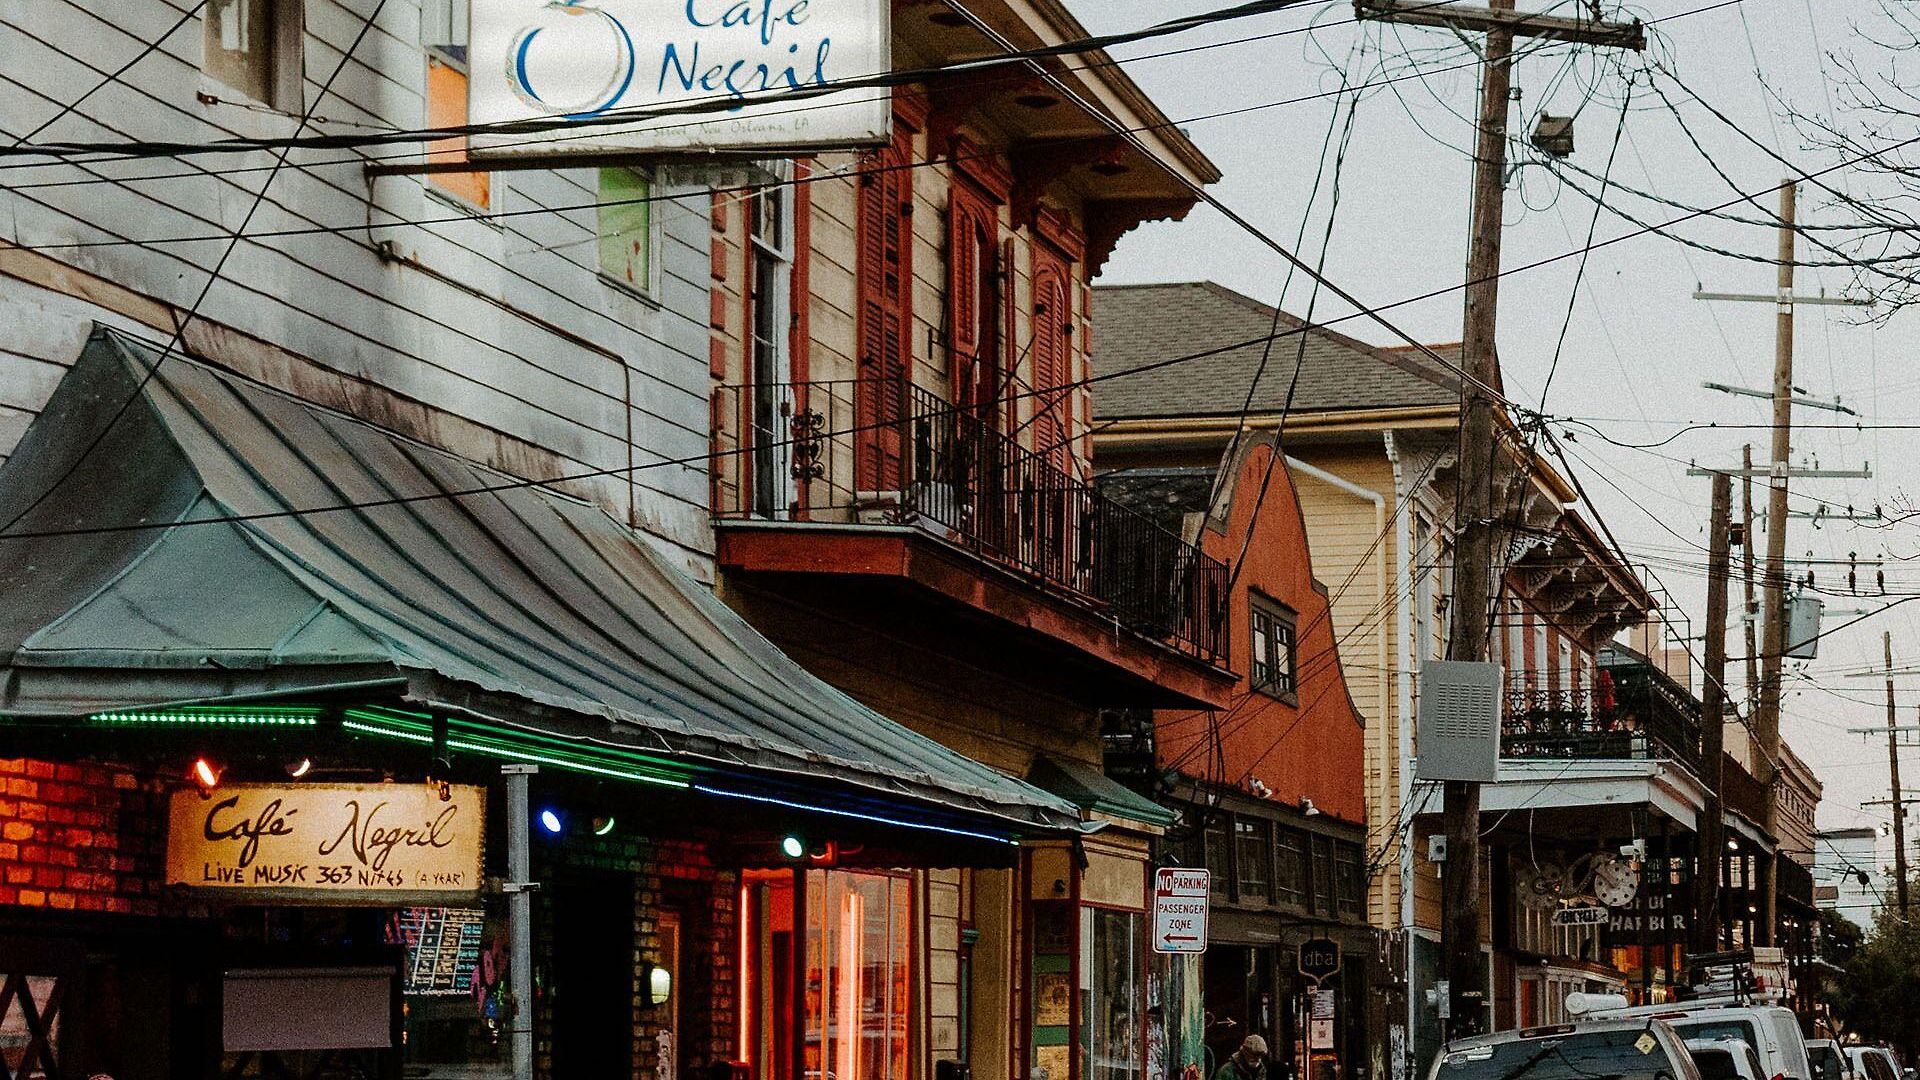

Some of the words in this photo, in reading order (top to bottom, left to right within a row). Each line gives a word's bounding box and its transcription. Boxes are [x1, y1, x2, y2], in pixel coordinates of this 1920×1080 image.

[658, 37, 834, 112] Negril
[795, 117, 810, 131] LA
[203, 795, 298, 868] Café
[318, 800, 458, 870] Negril
[315, 865, 352, 884] 363
[1158, 875, 1172, 891] NO
[1174, 877, 1206, 890] PARKING
[1159, 904, 1204, 915] PASSENGER
[1169, 919, 1192, 929] ZONE
[1305, 950, 1333, 966] dba
